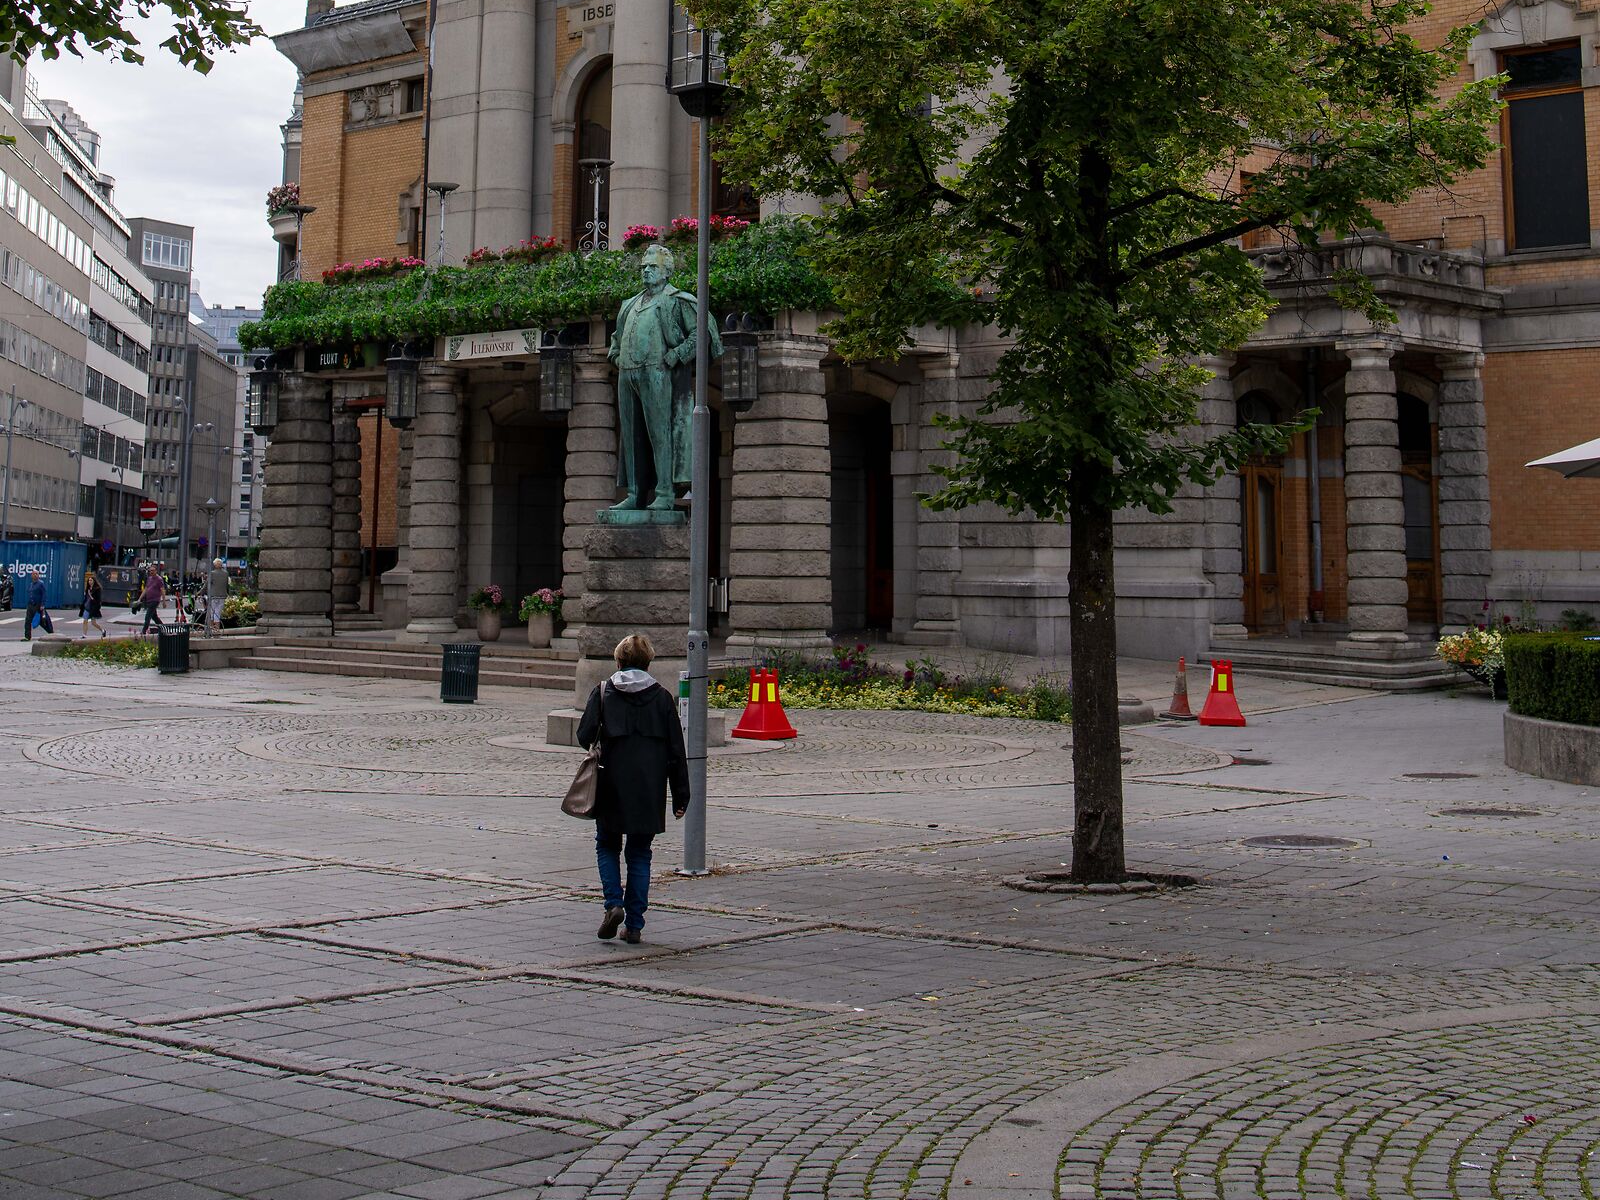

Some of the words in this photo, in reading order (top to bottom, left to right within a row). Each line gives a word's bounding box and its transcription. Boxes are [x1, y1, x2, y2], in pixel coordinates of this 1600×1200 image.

[583, 3, 615, 21] IBSE
[320, 352, 338, 365] FLUKT
[8, 559, 47, 578] algeco
